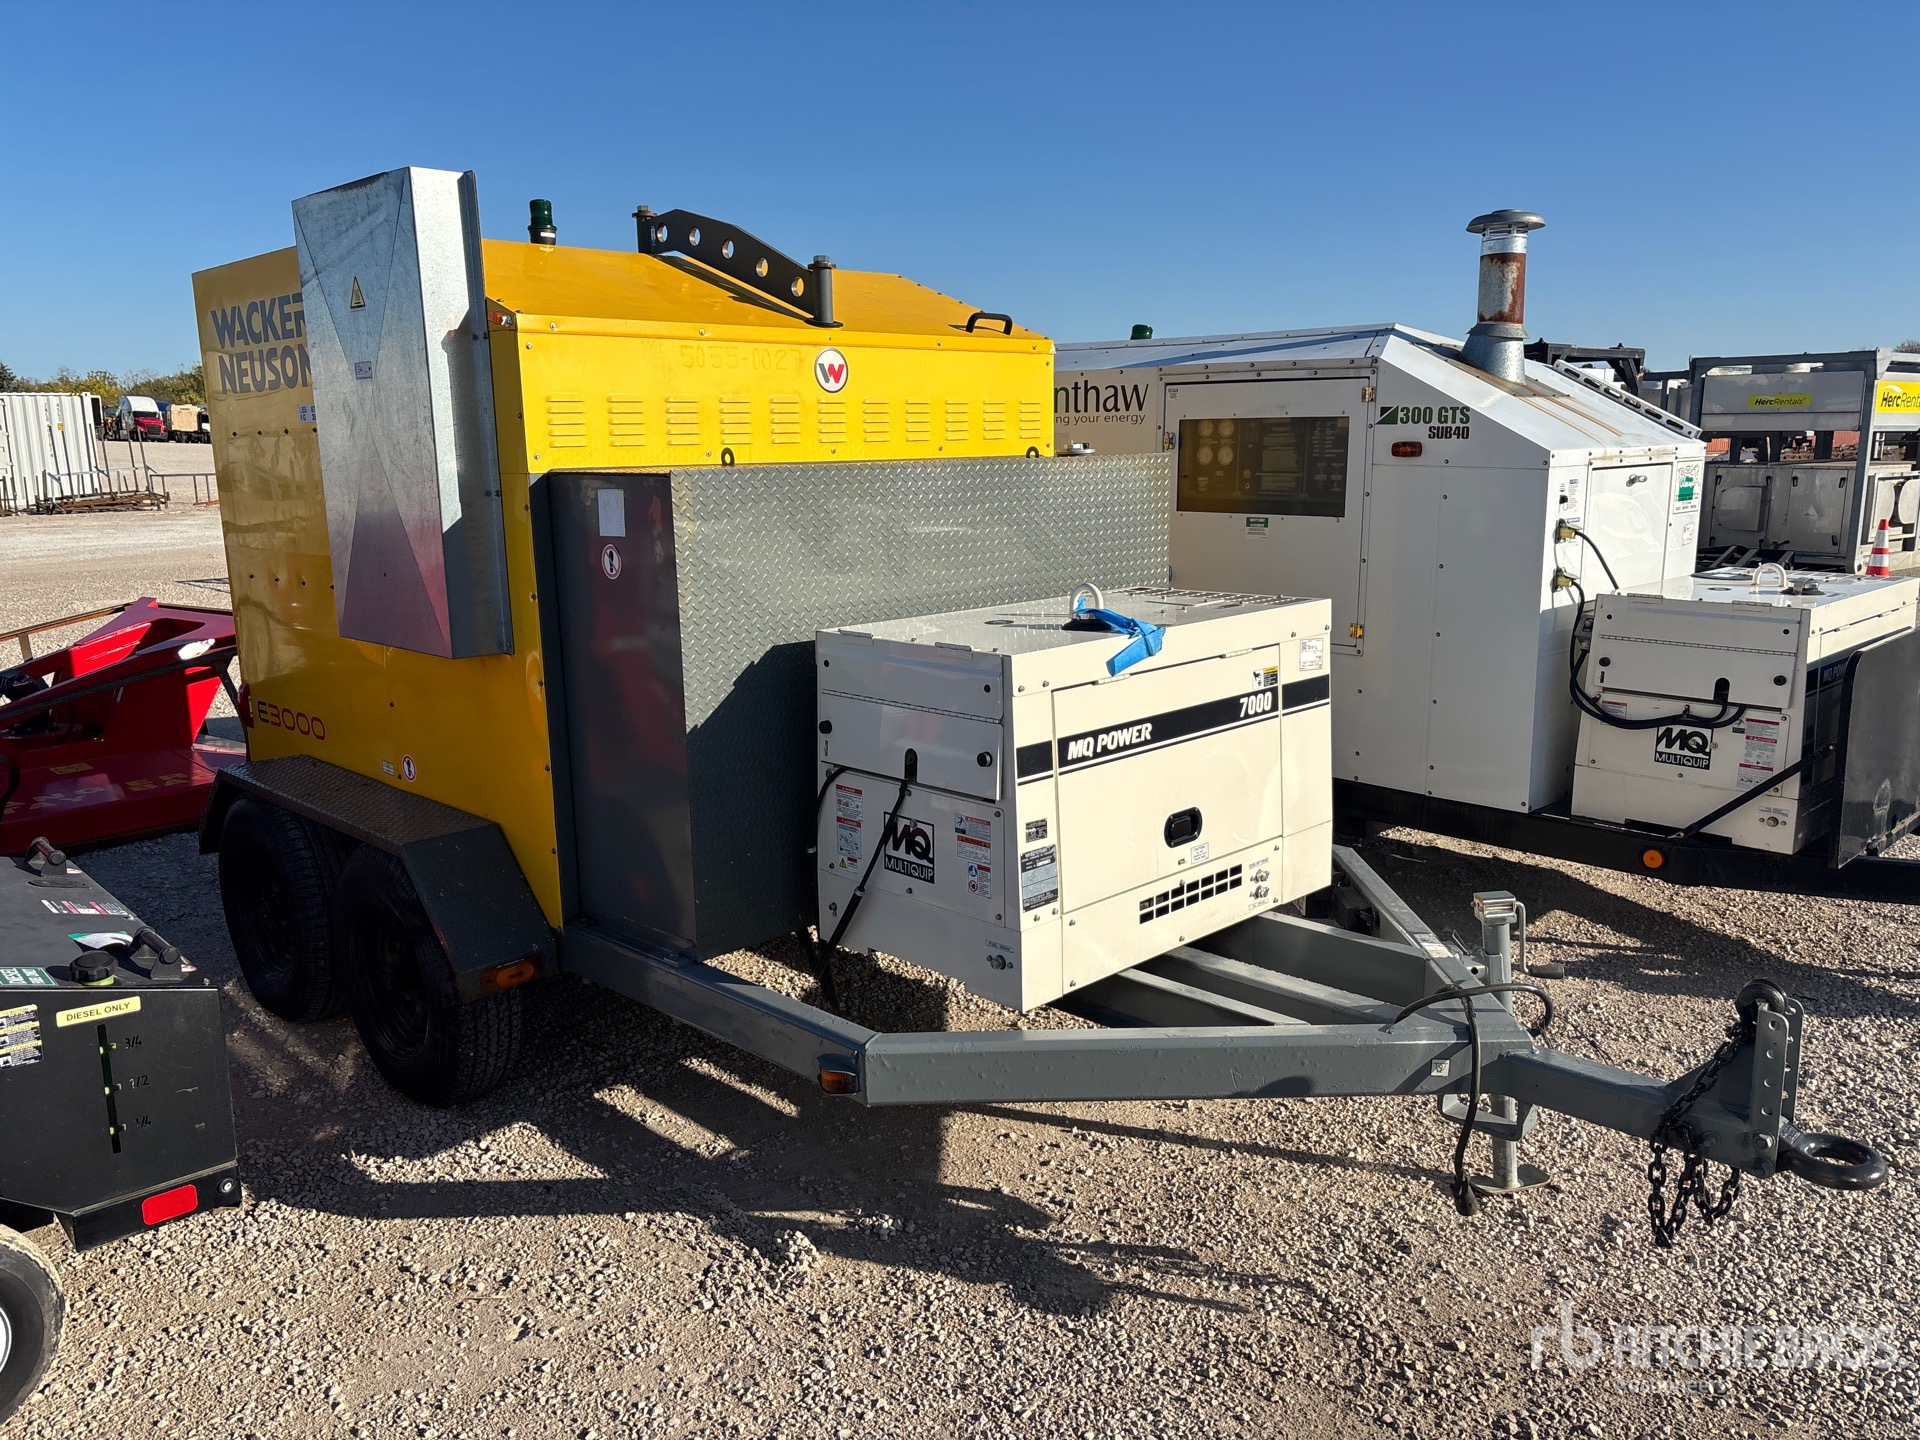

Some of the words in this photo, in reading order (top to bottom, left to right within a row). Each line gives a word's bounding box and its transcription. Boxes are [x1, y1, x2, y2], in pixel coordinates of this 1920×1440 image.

[210, 292, 306, 349] WACKER
[218, 344, 311, 395] NEUSON
[1881, 392, 1920, 407] HercRent
[1074, 415, 1100, 425] your
[1104, 414, 1146, 425] energy
[1399, 406, 1433, 425] 300
[1437, 406, 1470, 425] GTS
[1428, 426, 1470, 440] SUB40
[1239, 691, 1272, 718] 7000
[257, 700, 326, 741] E3000
[1067, 737, 1094, 760] MQ
[1096, 723, 1152, 753] POWER
[1657, 727, 1710, 755] MQ
[1655, 752, 1709, 769] MULTIQUIP
[886, 855, 934, 881] MULTIQUIP
[66, 1008, 102, 1021] DIESEL
[104, 1002, 131, 1014] ONLY
[125, 1035, 143, 1050] 3/4
